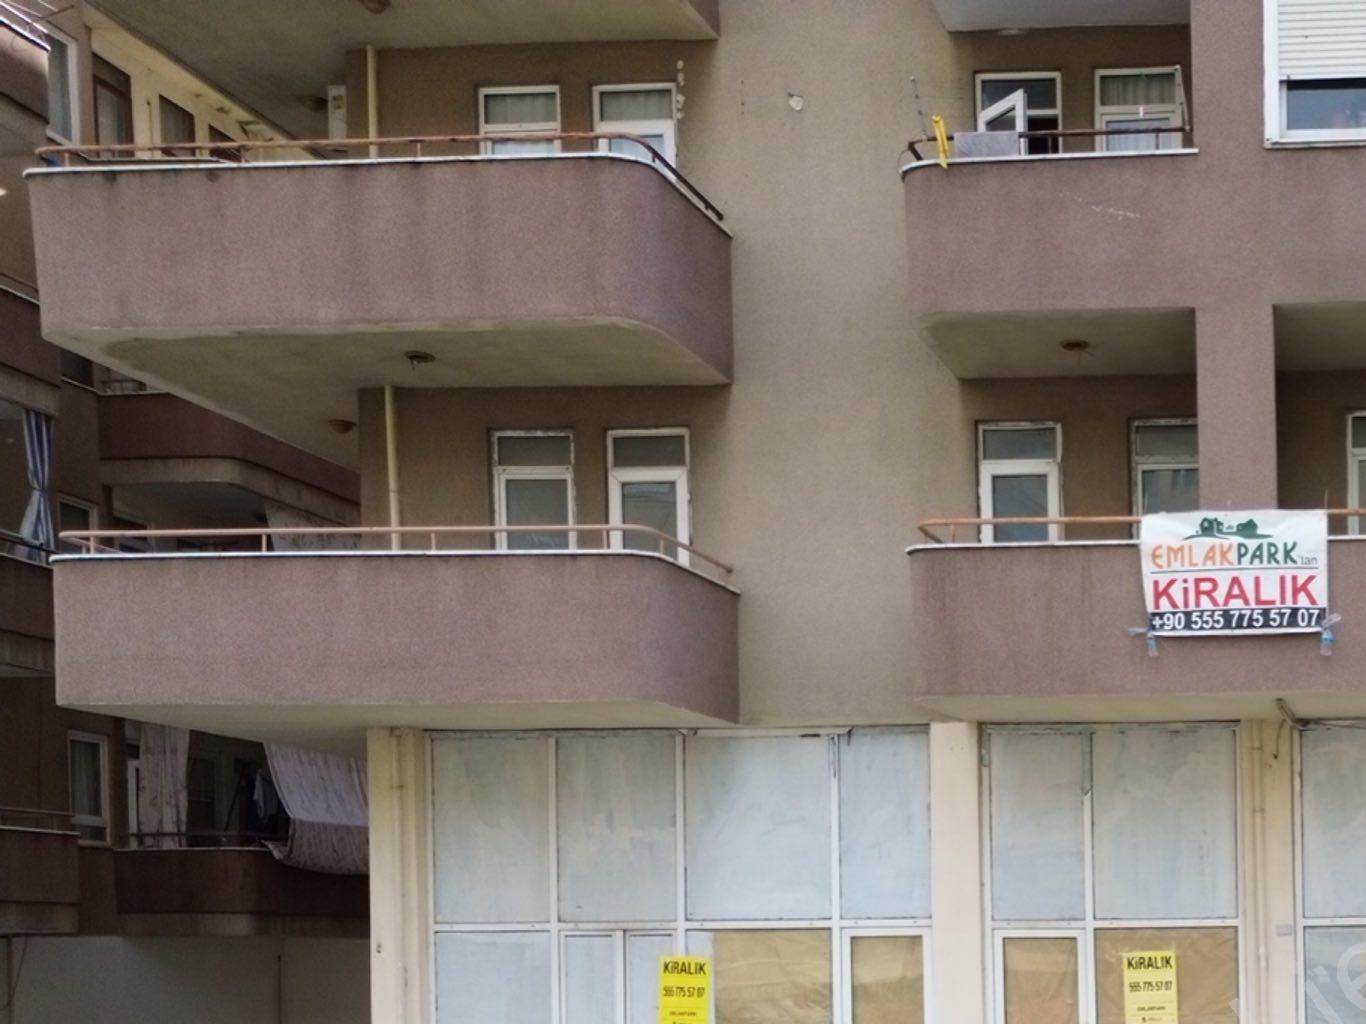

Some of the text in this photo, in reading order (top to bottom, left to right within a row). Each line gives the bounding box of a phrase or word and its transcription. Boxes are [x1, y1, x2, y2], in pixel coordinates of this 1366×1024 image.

[1152, 609, 1320, 630] +90 555 775 57 07
